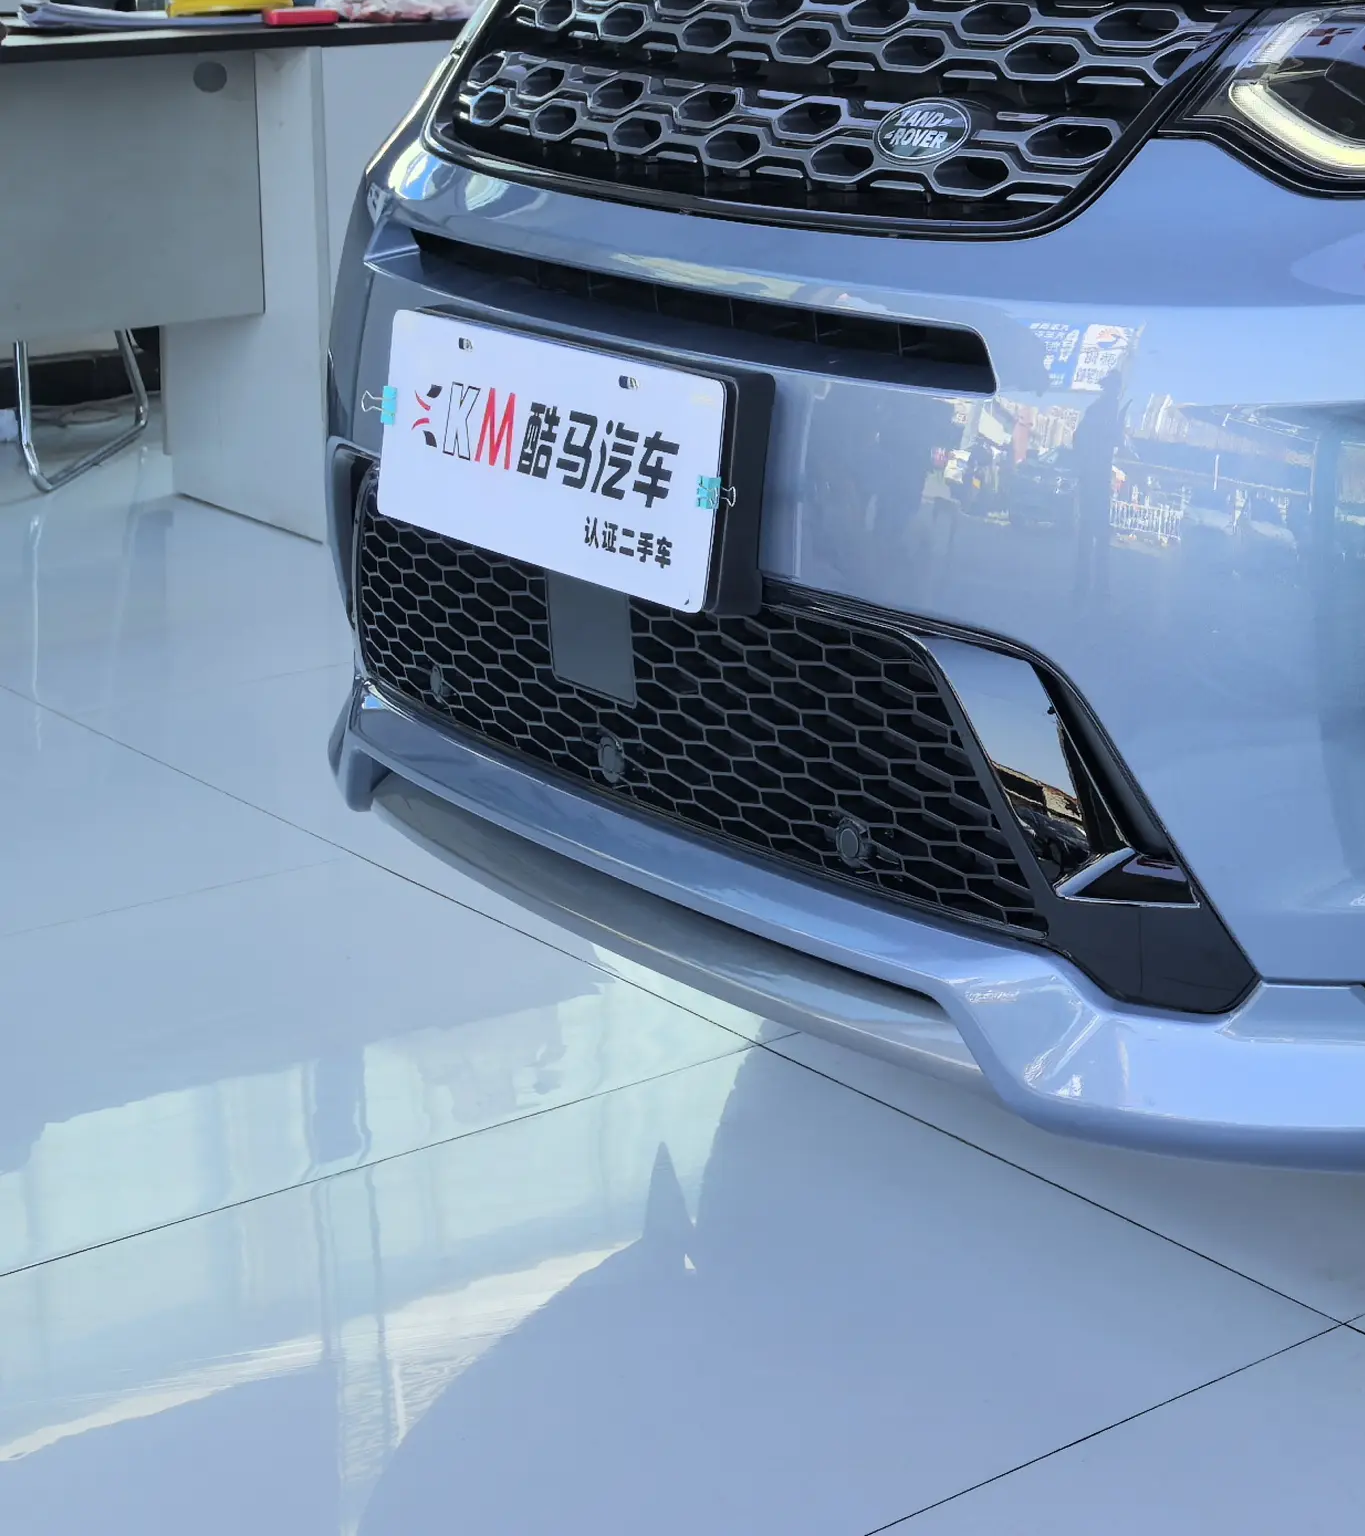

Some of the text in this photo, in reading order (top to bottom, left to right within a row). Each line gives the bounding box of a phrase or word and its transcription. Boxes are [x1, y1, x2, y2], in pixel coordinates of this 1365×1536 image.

[895, 109, 945, 128] LAND
[889, 127, 949, 149] ROVER
[516, 401, 681, 509] 酷马汽车
[584, 516, 674, 570] 认证二手车
